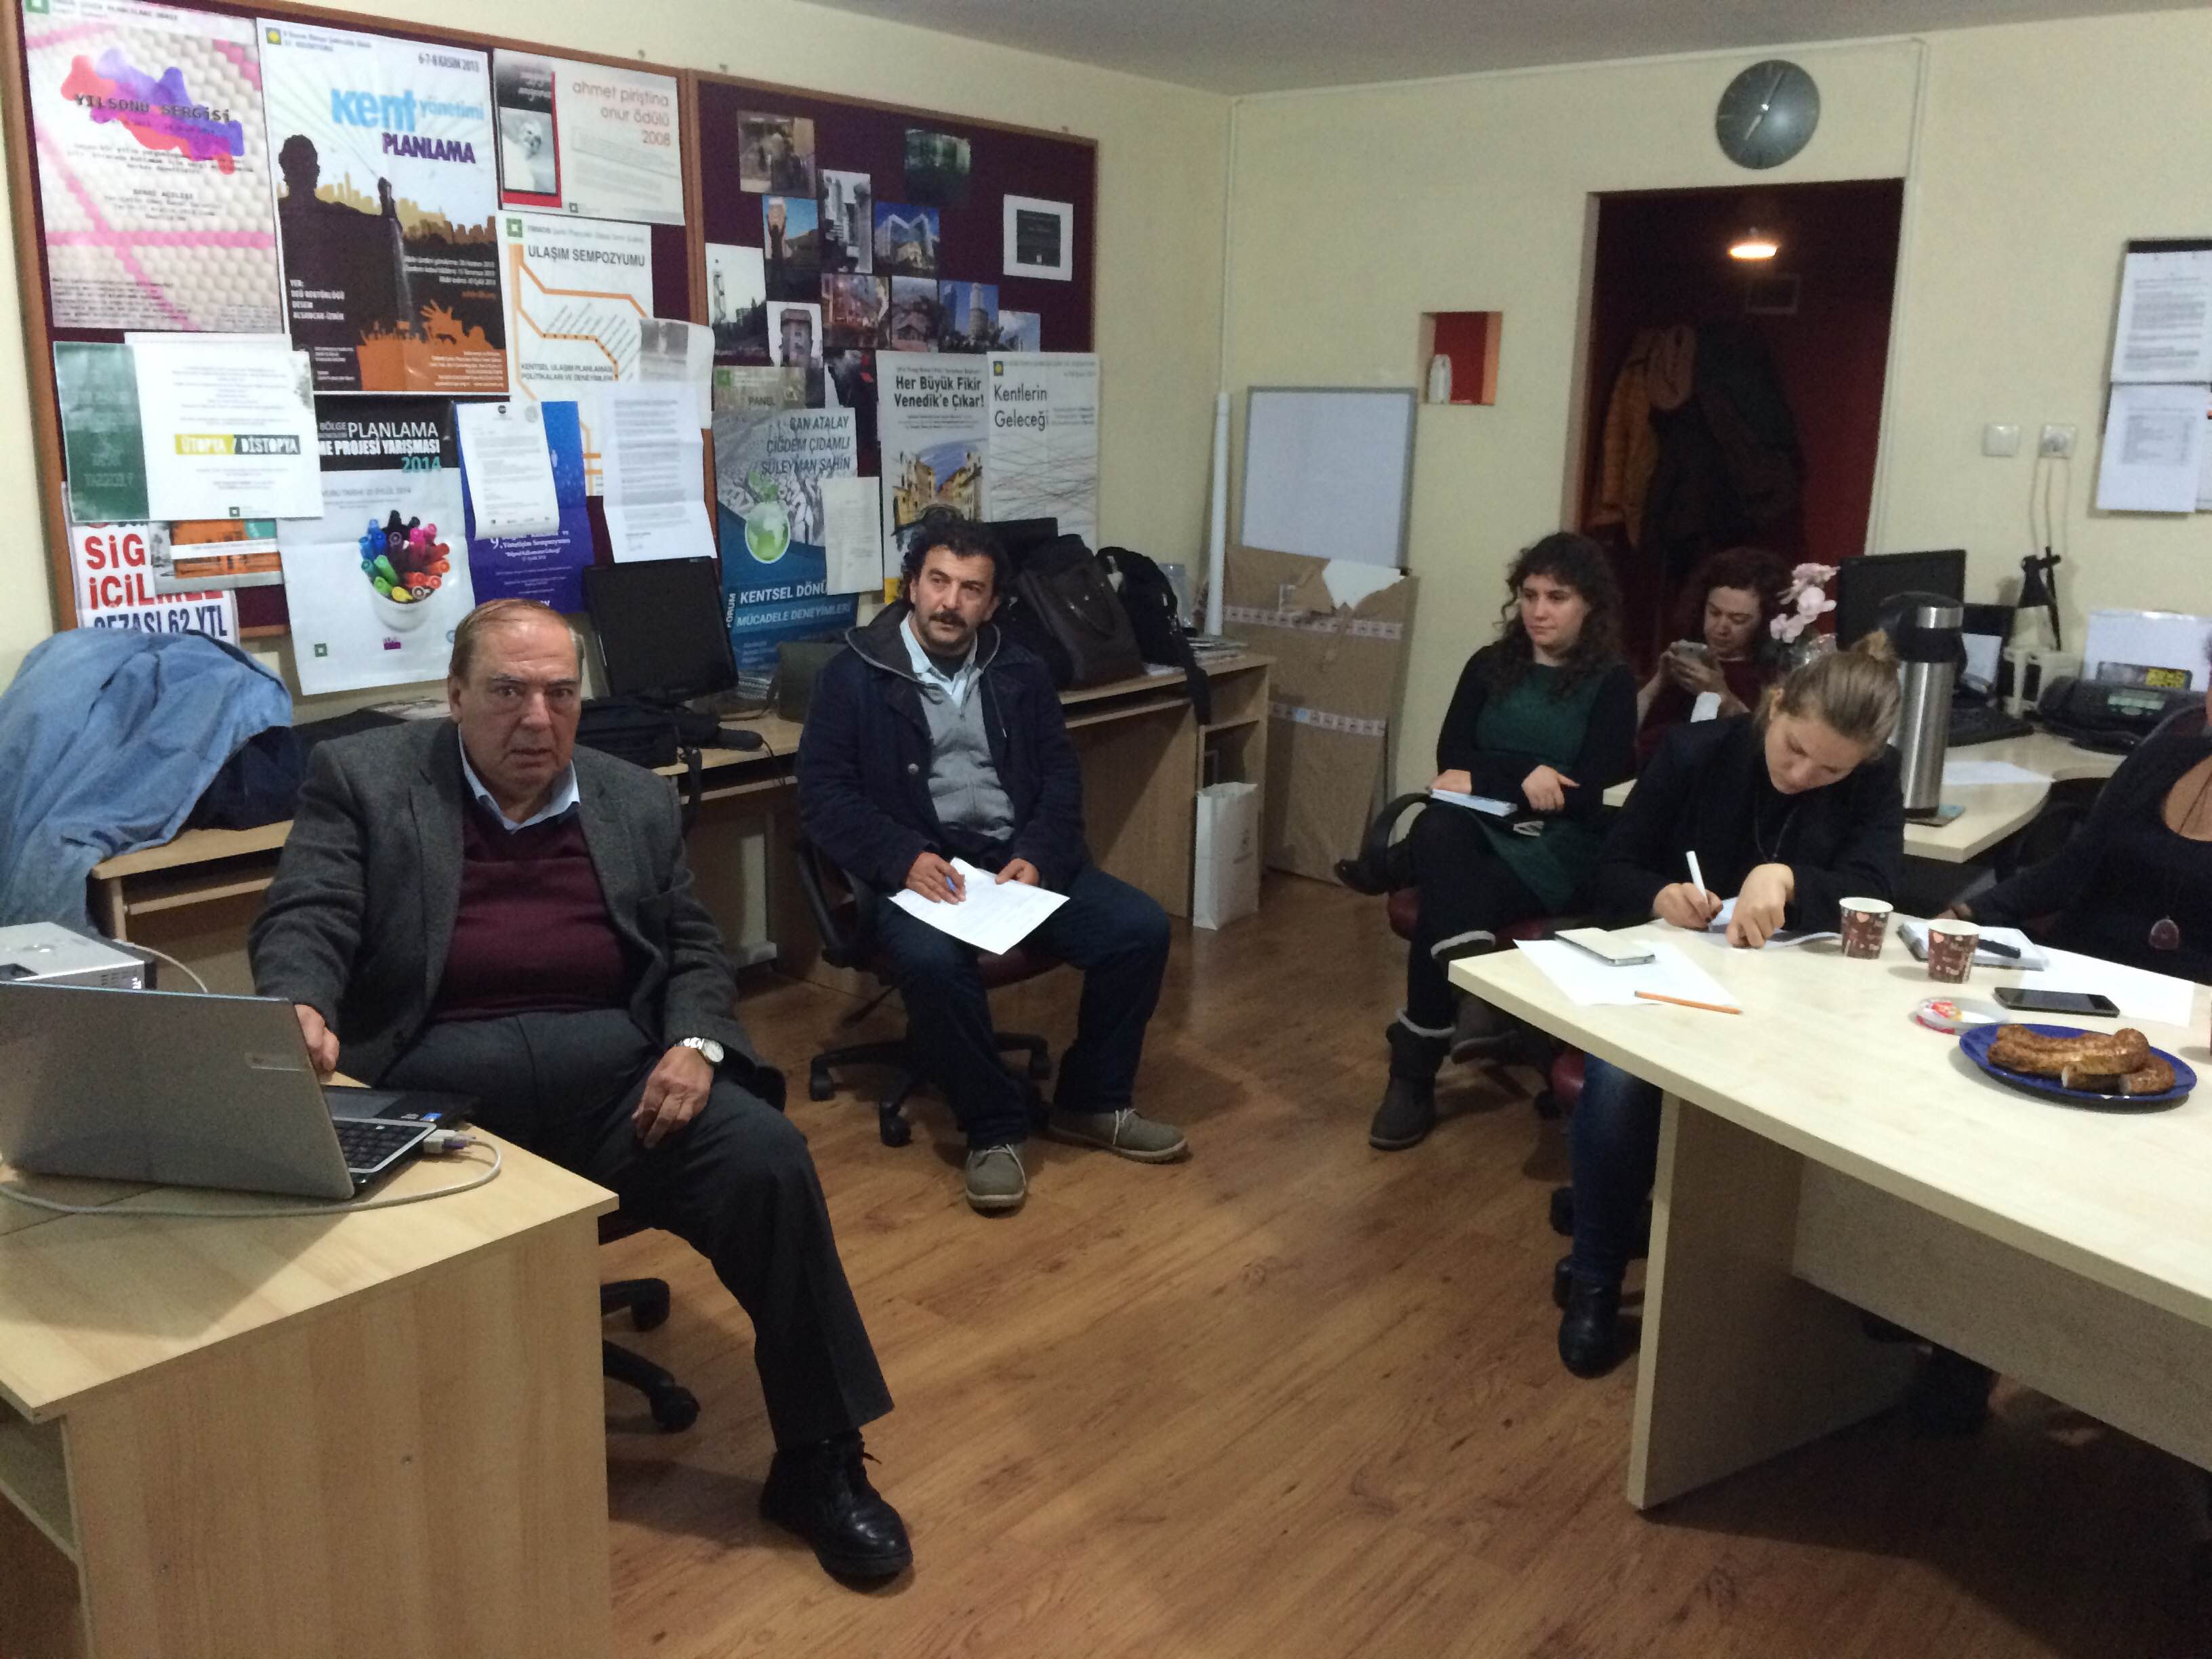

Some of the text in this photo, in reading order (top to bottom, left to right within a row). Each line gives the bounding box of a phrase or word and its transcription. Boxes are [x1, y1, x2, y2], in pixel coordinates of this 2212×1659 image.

[573, 81, 617, 98] ahmet
[75, 94, 149, 113] YILSONU
[331, 88, 416, 132] kent
[600, 106, 670, 127] onur ödülü
[382, 131, 476, 164] PLANLAMA
[528, 245, 645, 267] ULAŞIM SEMPOZYUMU
[896, 375, 981, 393] Her Büyük Fikir
[994, 384, 1048, 402] Kentlerin
[895, 394, 985, 411] Venedik'e Çıkar!
[348, 422, 439, 438] PLANLAMA
[813, 416, 849, 430] ATALAY
[766, 436, 808, 457] ÇİĞDEM
[401, 455, 442, 473] 2014
[740, 586, 793, 605] KENTSEL
[168, 609, 190, 633] 62
[196, 605, 228, 637] YTL
[737, 611, 789, 628] MÜCADELE
